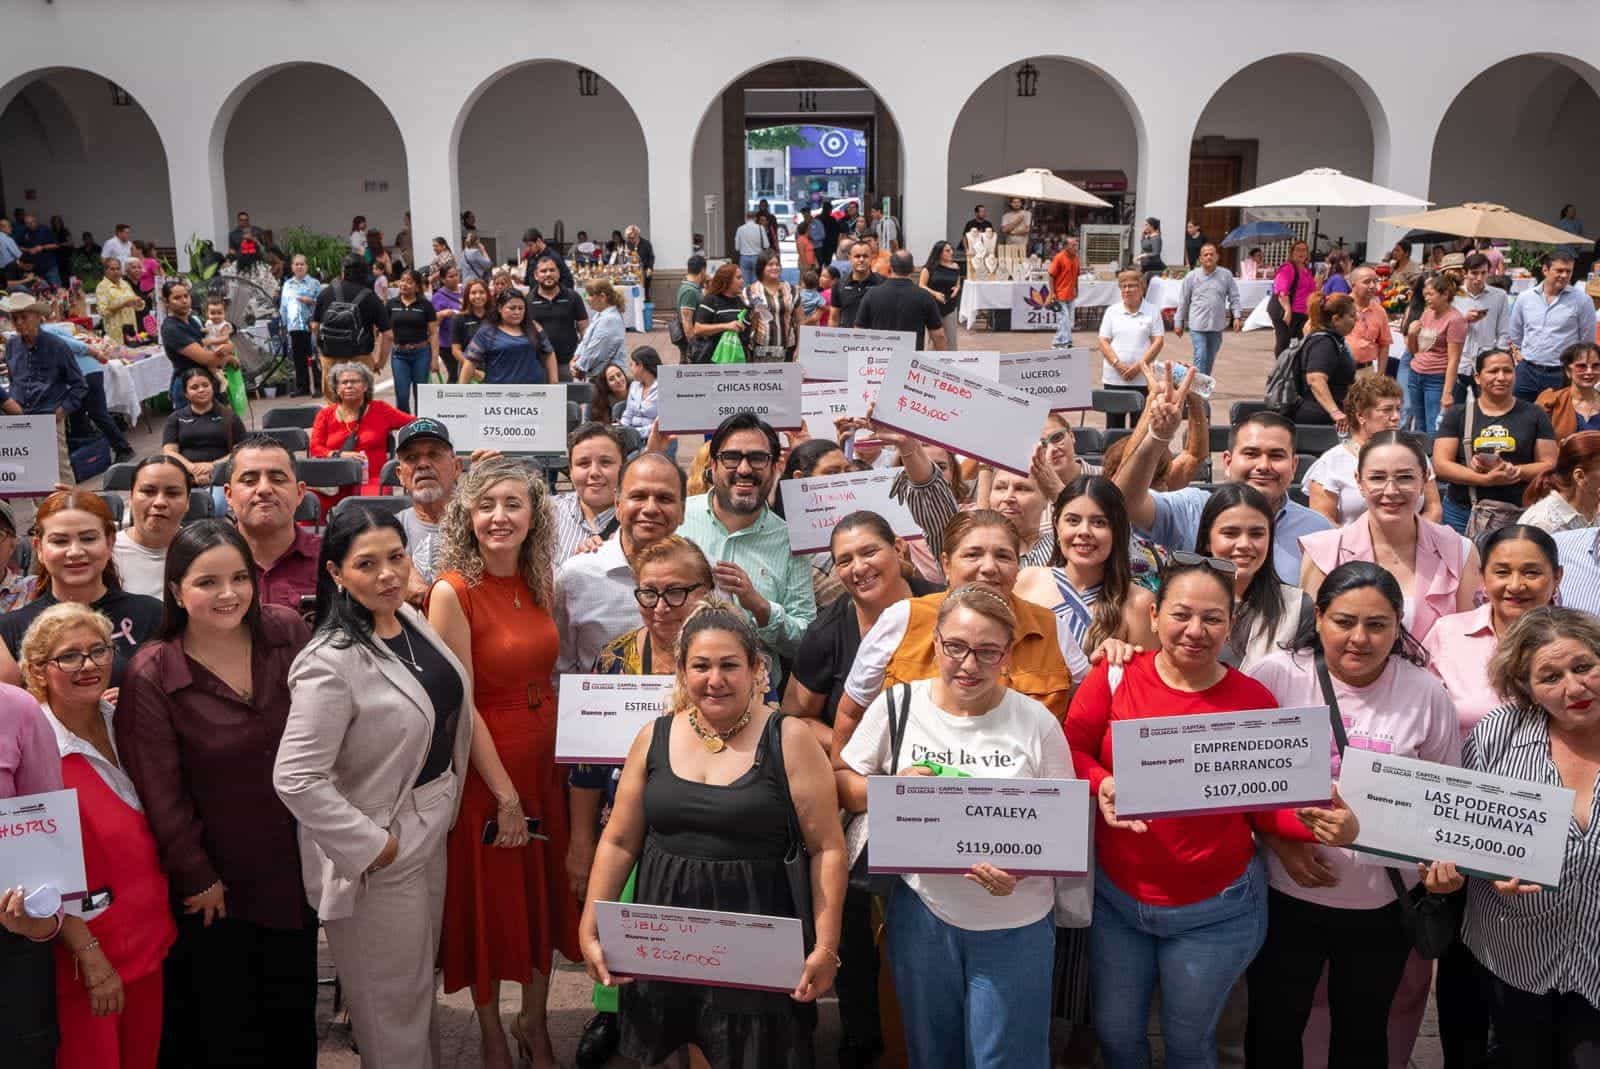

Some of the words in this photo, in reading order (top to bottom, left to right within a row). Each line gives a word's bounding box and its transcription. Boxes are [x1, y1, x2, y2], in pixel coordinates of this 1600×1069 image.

[1020, 369, 1061, 379] LUCEROS
[716, 382, 750, 392] CHICAS
[752, 382, 783, 391] ROSAL
[484, 407, 502, 416] LAS
[503, 407, 539, 416] CHICAS
[483, 427, 536, 438] $75,000.00
[1193, 737, 1309, 755] EMPRENDEDORAS
[959, 748, 978, 765] la
[980, 749, 1016, 768] vie.
[1194, 762, 1211, 773] DE
[1213, 757, 1293, 772] BARRANCOS
[1204, 780, 1288, 799] $107,000.00
[965, 805, 1038, 820] CATALEYA
[1425, 790, 1451, 804] LAS
[1455, 795, 1547, 824] PODEROSAS
[1434, 805, 1461, 821] DEL
[1465, 811, 1534, 836] HUMAYA
[956, 841, 1042, 856] $119,000.00
[1435, 830, 1526, 858] $125,000.00
